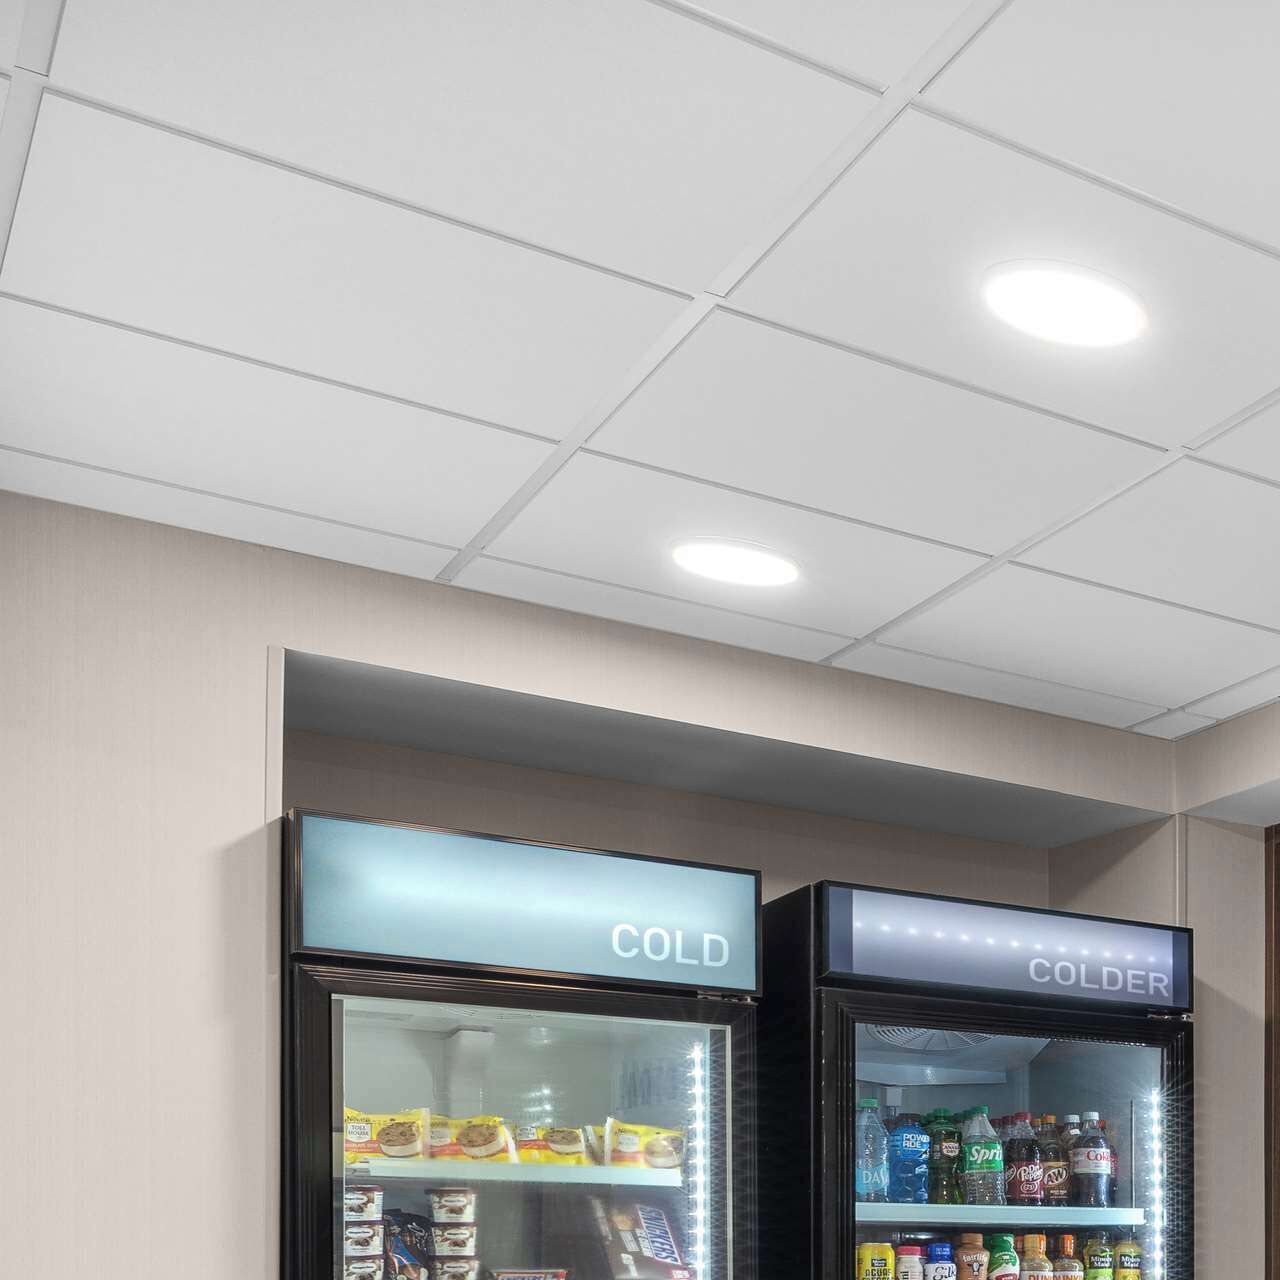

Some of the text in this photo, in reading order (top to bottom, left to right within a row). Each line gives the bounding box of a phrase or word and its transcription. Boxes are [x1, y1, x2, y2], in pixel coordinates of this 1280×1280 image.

[612, 923, 730, 968] COLD
[1029, 958, 1169, 997] COLDER
[971, 1146, 1001, 1163] Spri
[932, 1263, 957, 1280] Silk
